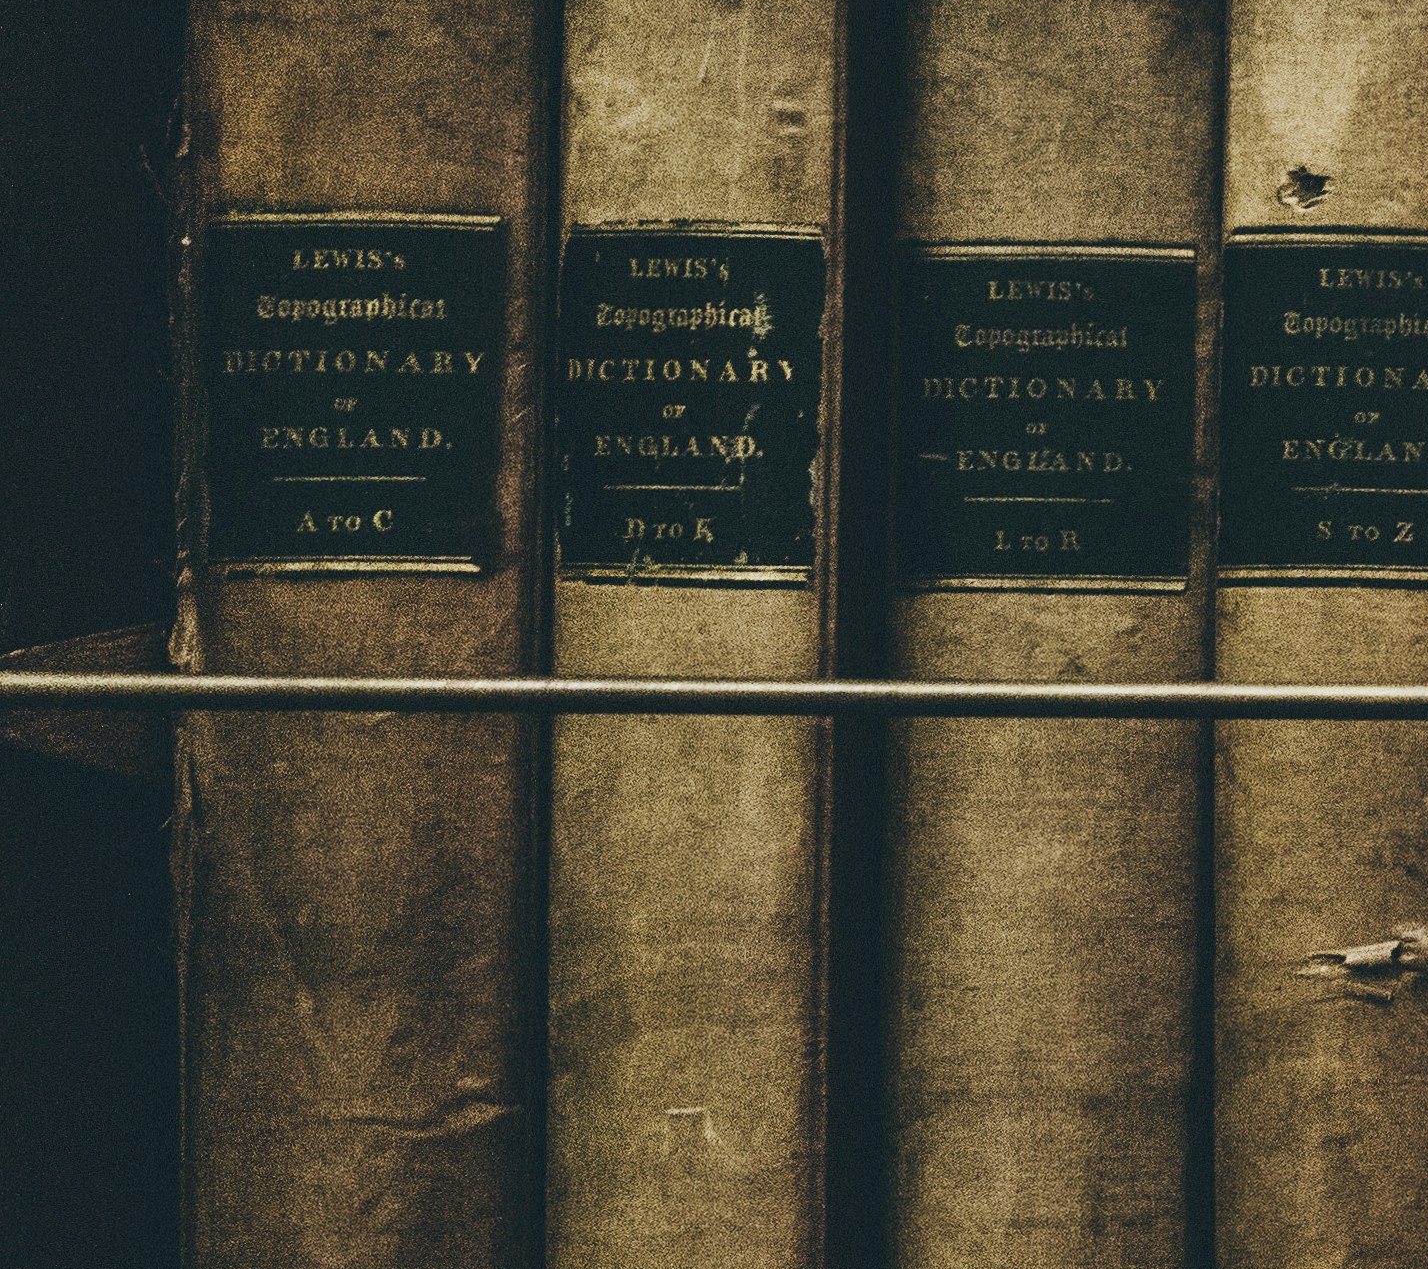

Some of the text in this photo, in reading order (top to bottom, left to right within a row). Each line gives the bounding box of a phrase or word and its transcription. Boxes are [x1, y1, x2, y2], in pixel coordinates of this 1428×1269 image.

[223, 349, 485, 375] DICTIONARY
[568, 358, 793, 382] DICTIONARY
[922, 377, 1164, 401] DICTIONARY
[260, 426, 452, 449] ENGLAND.
[594, 435, 763, 457] ENGLAND.
[956, 449, 1133, 472] ENGLAND.
[297, 510, 318, 532] A
[372, 509, 394, 531] C
[625, 517, 645, 539] D
[694, 518, 714, 543] K
[1317, 521, 1332, 540] S
[1393, 521, 1415, 542] Z
[993, 529, 1011, 551] L
[1060, 529, 1080, 551] R
